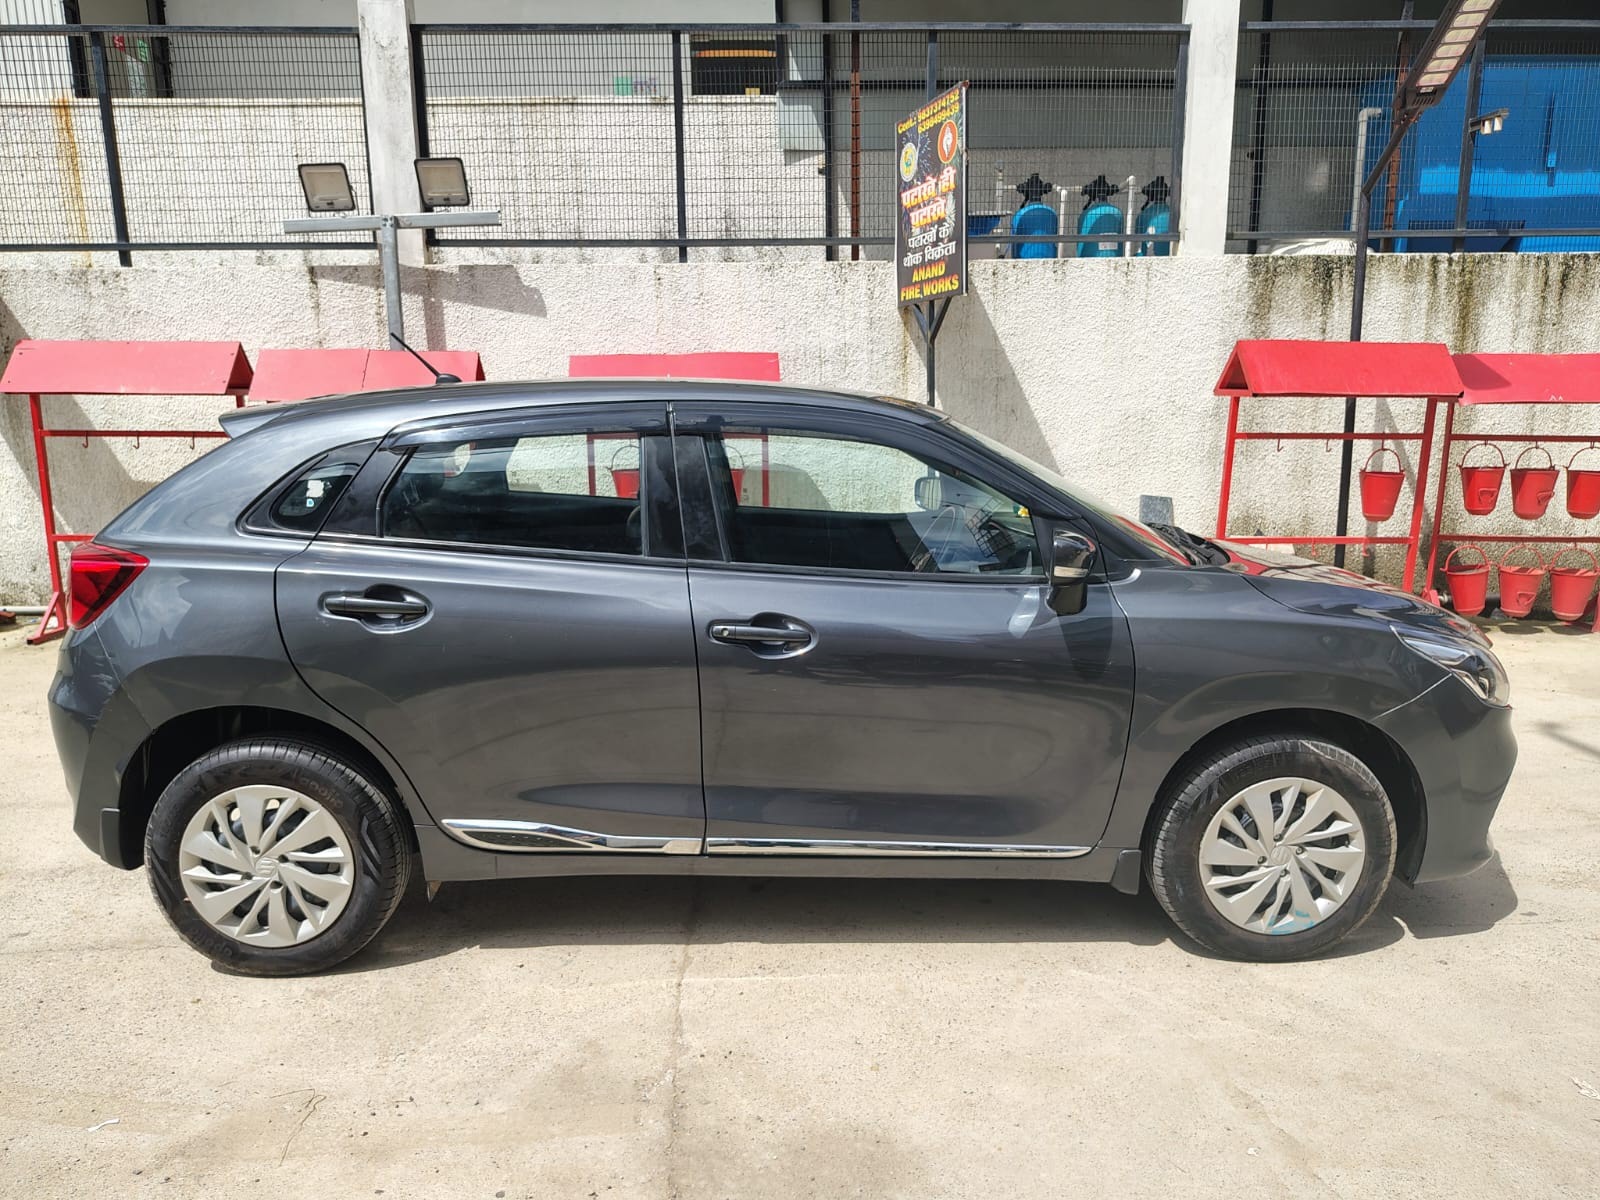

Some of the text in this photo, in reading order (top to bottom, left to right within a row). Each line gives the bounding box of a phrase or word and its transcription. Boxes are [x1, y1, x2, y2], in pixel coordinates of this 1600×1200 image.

[938, 222, 950, 238] के
[903, 241, 957, 267] थोक विक्रेता
[912, 260, 946, 283] ANAND
[900, 273, 960, 302] FIRE WORKS
